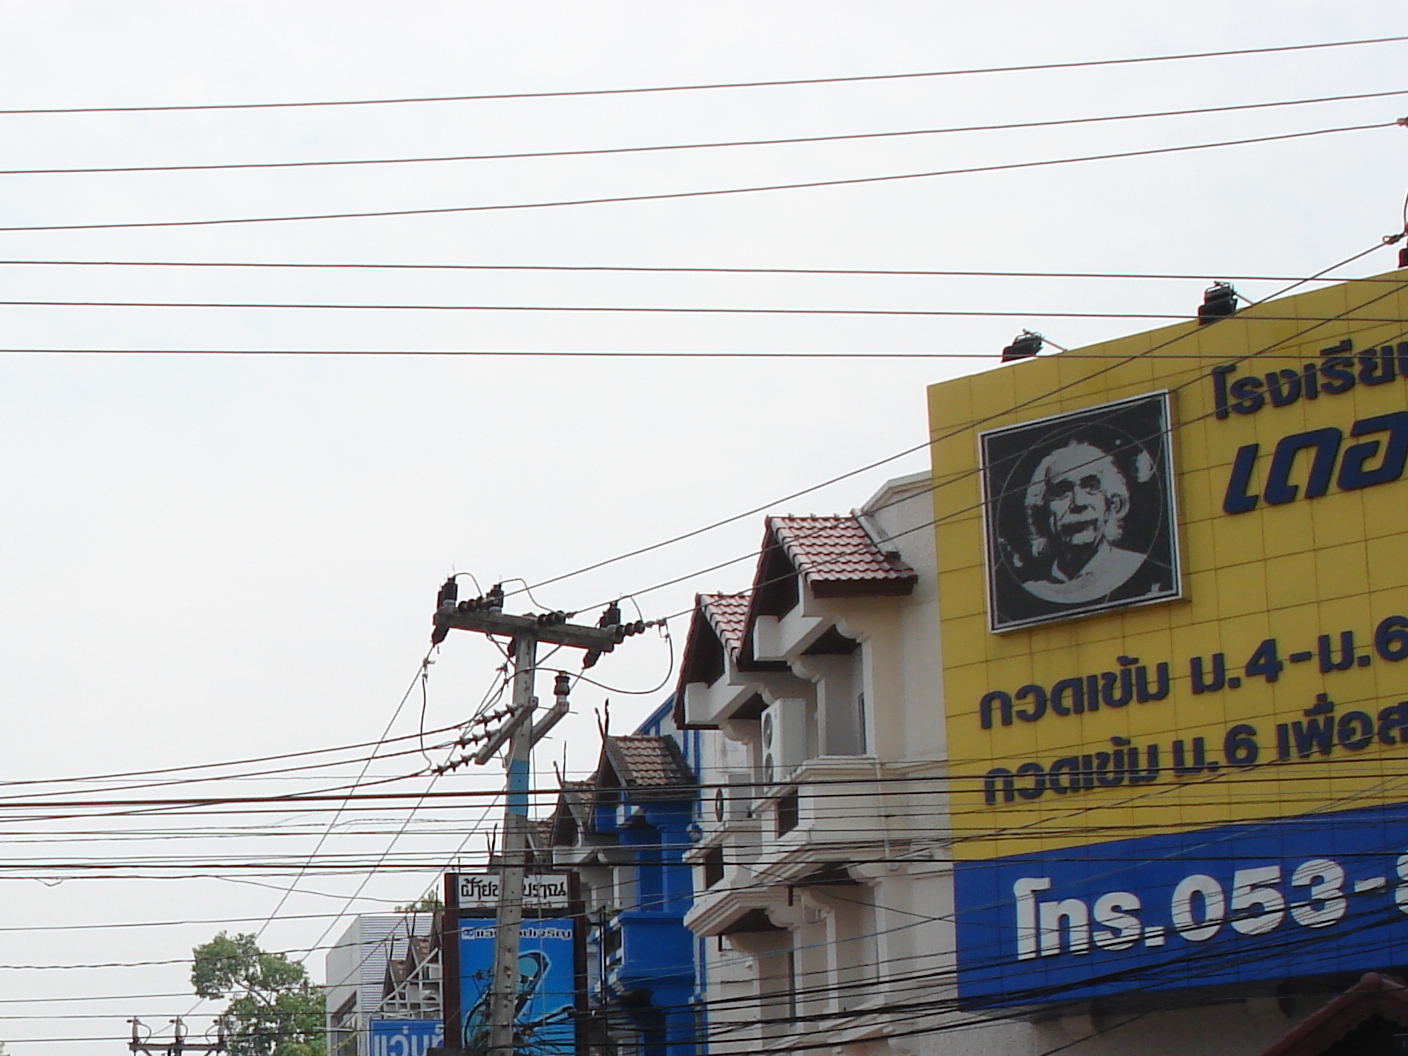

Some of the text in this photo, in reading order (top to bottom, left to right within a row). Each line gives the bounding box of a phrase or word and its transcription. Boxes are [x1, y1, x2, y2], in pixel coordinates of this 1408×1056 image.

[1211, 338, 1408, 420] โรงเรีย
[979, 655, 1171, 730] กวดเข้ม
[984, 736, 1160, 805] กวดเข้ม
[1012, 852, 1408, 961] โทร.053-
